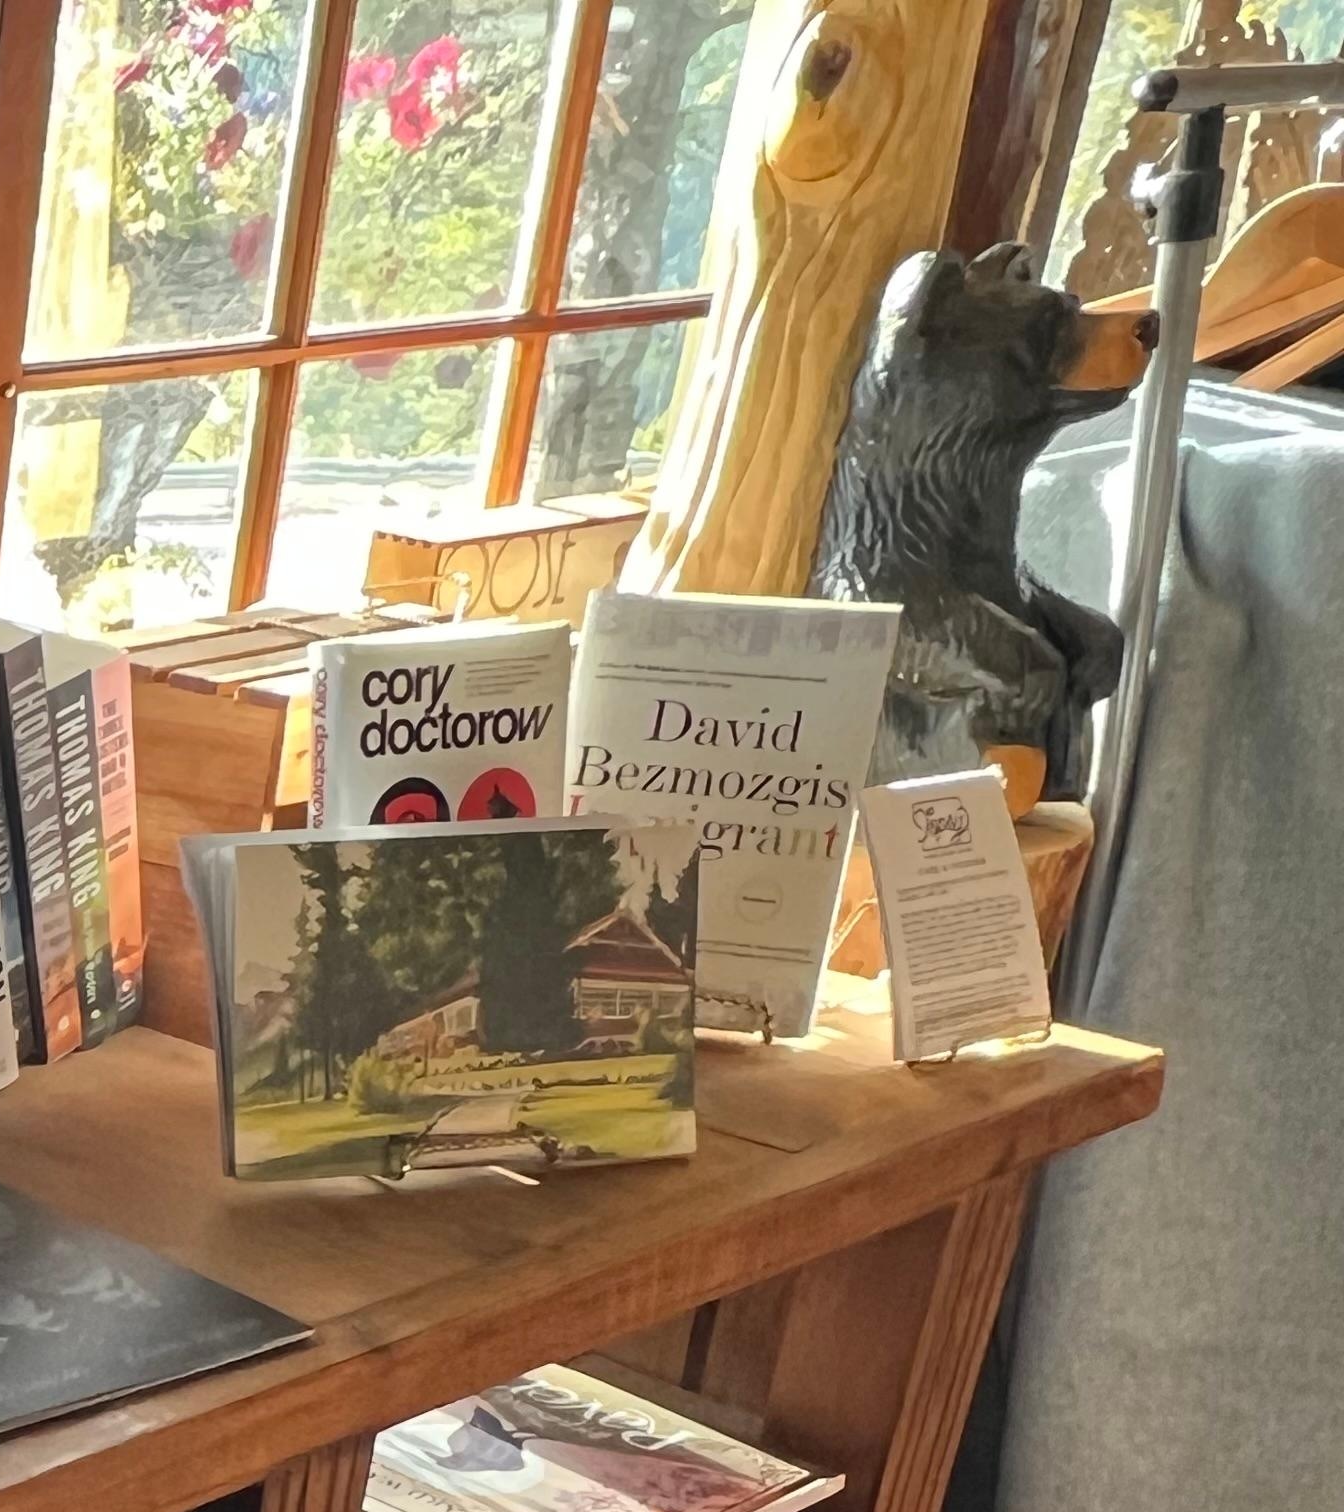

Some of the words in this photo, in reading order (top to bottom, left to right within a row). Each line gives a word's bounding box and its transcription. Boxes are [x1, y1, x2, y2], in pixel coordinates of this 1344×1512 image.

[362, 663, 456, 718] cory
[645, 698, 804, 753] David
[9, 666, 56, 813] THOMAS
[55, 695, 95, 828] THOMAS
[360, 702, 554, 758] doctorow
[570, 744, 850, 816] Bezmozgis
[23, 813, 66, 904] KING
[67, 827, 102, 909] KING
